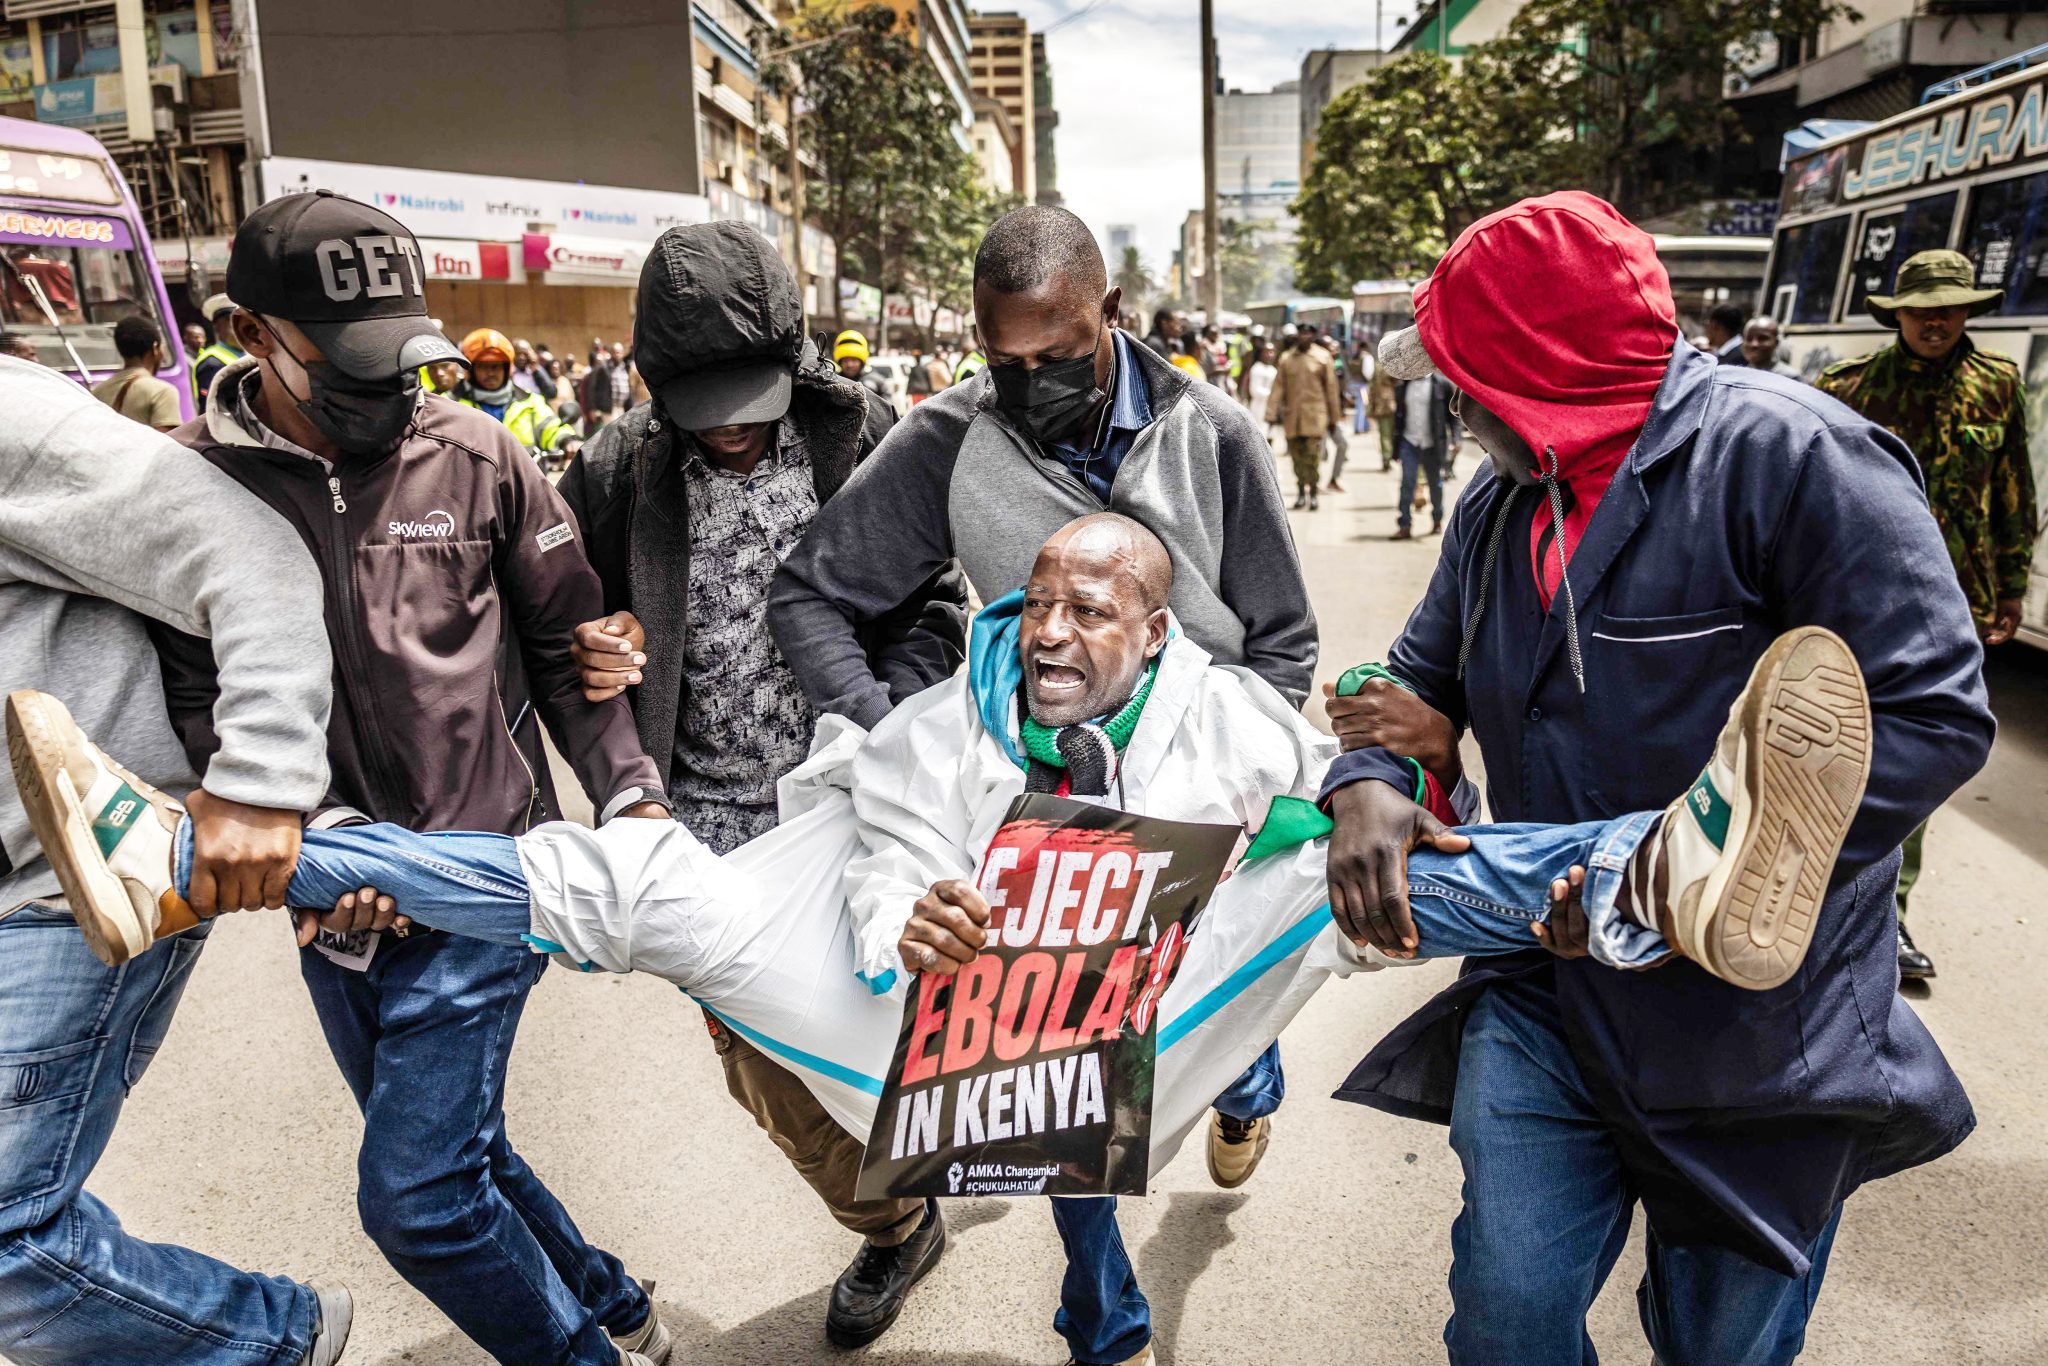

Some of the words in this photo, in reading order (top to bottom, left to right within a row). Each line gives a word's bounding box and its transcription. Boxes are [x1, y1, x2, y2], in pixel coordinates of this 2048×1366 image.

[400, 195, 465, 212] Nairobi
[583, 208, 637, 226] Nairobi
[315, 235, 422, 302] GET
[553, 247, 625, 270] Creamy
[416, 340, 455, 358] GET
[980, 848, 1174, 948] EJECT
[900, 944, 1139, 1088] EBOLA
[890, 1085, 945, 1161] IN
[953, 1052, 1107, 1148] KENYA
[967, 1164, 1003, 1178] AMKA
[1005, 1163, 1060, 1179] Changamka!
[966, 1180, 1041, 1192] #CHUKUAHATUA
